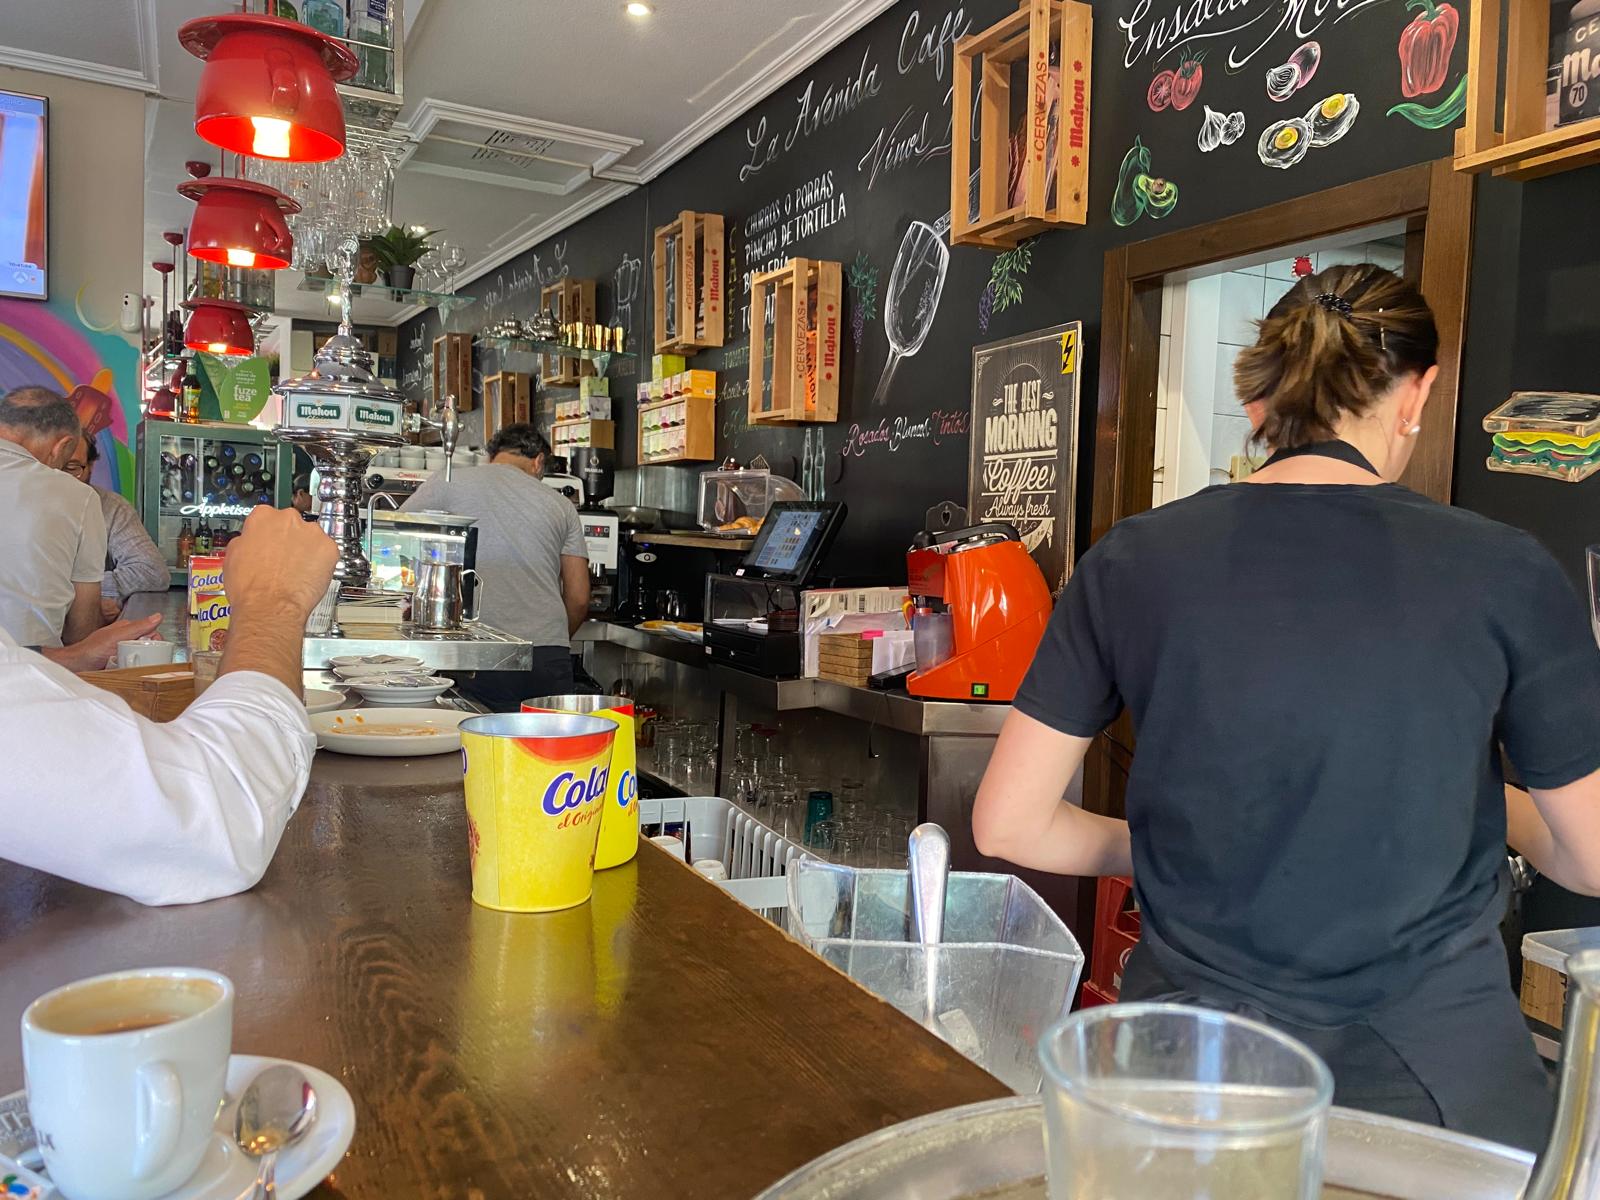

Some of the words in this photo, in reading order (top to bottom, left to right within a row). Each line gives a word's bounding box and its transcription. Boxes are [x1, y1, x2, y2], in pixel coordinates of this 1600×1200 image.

[739, 116, 779, 182] La
[784, 44, 882, 152] Avenida
[1033, 60, 1047, 151] CERVEZAS
[1070, 79, 1085, 149] Mahou
[1572, 85, 1586, 104] 70
[784, 193, 791, 216] O
[796, 169, 834, 213] PORRAS
[781, 220, 795, 247] DE
[795, 192, 847, 242] TORTILLA
[685, 252, 694, 305] CERVEZAS
[710, 259, 720, 301] Mahou
[797, 307, 806, 372] CERVEZAS
[824, 317, 836, 367] Mahou
[234, 385, 257, 396] fuze
[234, 394, 251, 402] tea
[301, 406, 337, 416] Mahou
[1004, 384, 1018, 414] THE
[1021, 380, 1042, 412] BEST
[359, 410, 391, 422] Mahou
[985, 408, 1058, 453] MORNING
[988, 458, 1049, 504] Coffee
[180, 502, 256, 517] Appletise
[985, 497, 1024, 527] Always
[1025, 495, 1051, 525] fresh
[557, 813, 571, 830] el
